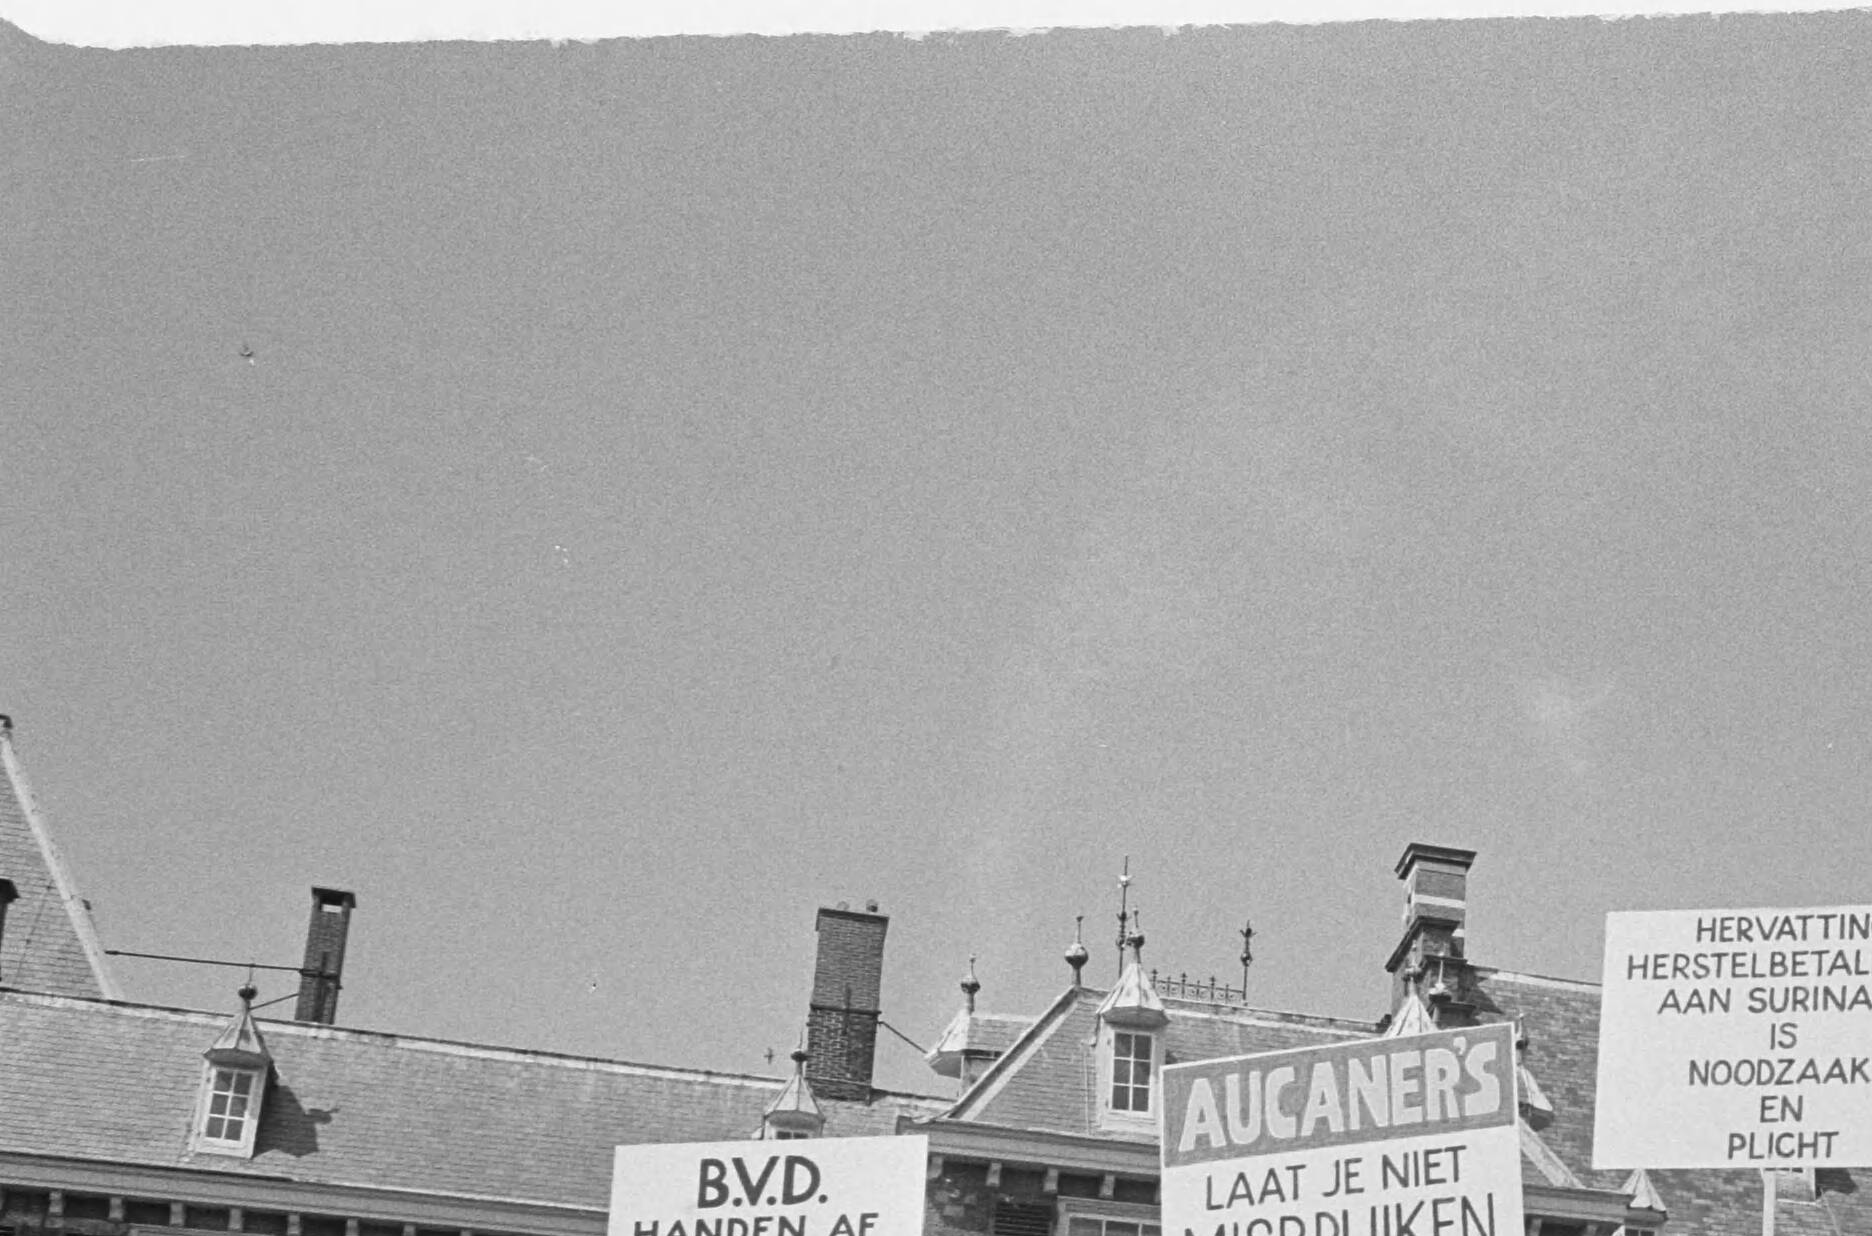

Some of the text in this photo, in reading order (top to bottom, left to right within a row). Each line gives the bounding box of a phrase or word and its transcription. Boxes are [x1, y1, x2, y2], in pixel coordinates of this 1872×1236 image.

[1657, 987, 1732, 1015] AAN
[1769, 1021, 1799, 1050] IS
[1688, 1056, 1872, 1087] NOODZAAK
[1178, 1036, 1501, 1153] AUCANER'S
[1759, 1094, 1804, 1124] EN
[1727, 1130, 1840, 1161] PLICHT
[697, 1154, 829, 1208] B.V.D.
[1205, 1144, 1468, 1211] LAAT JE NIET
